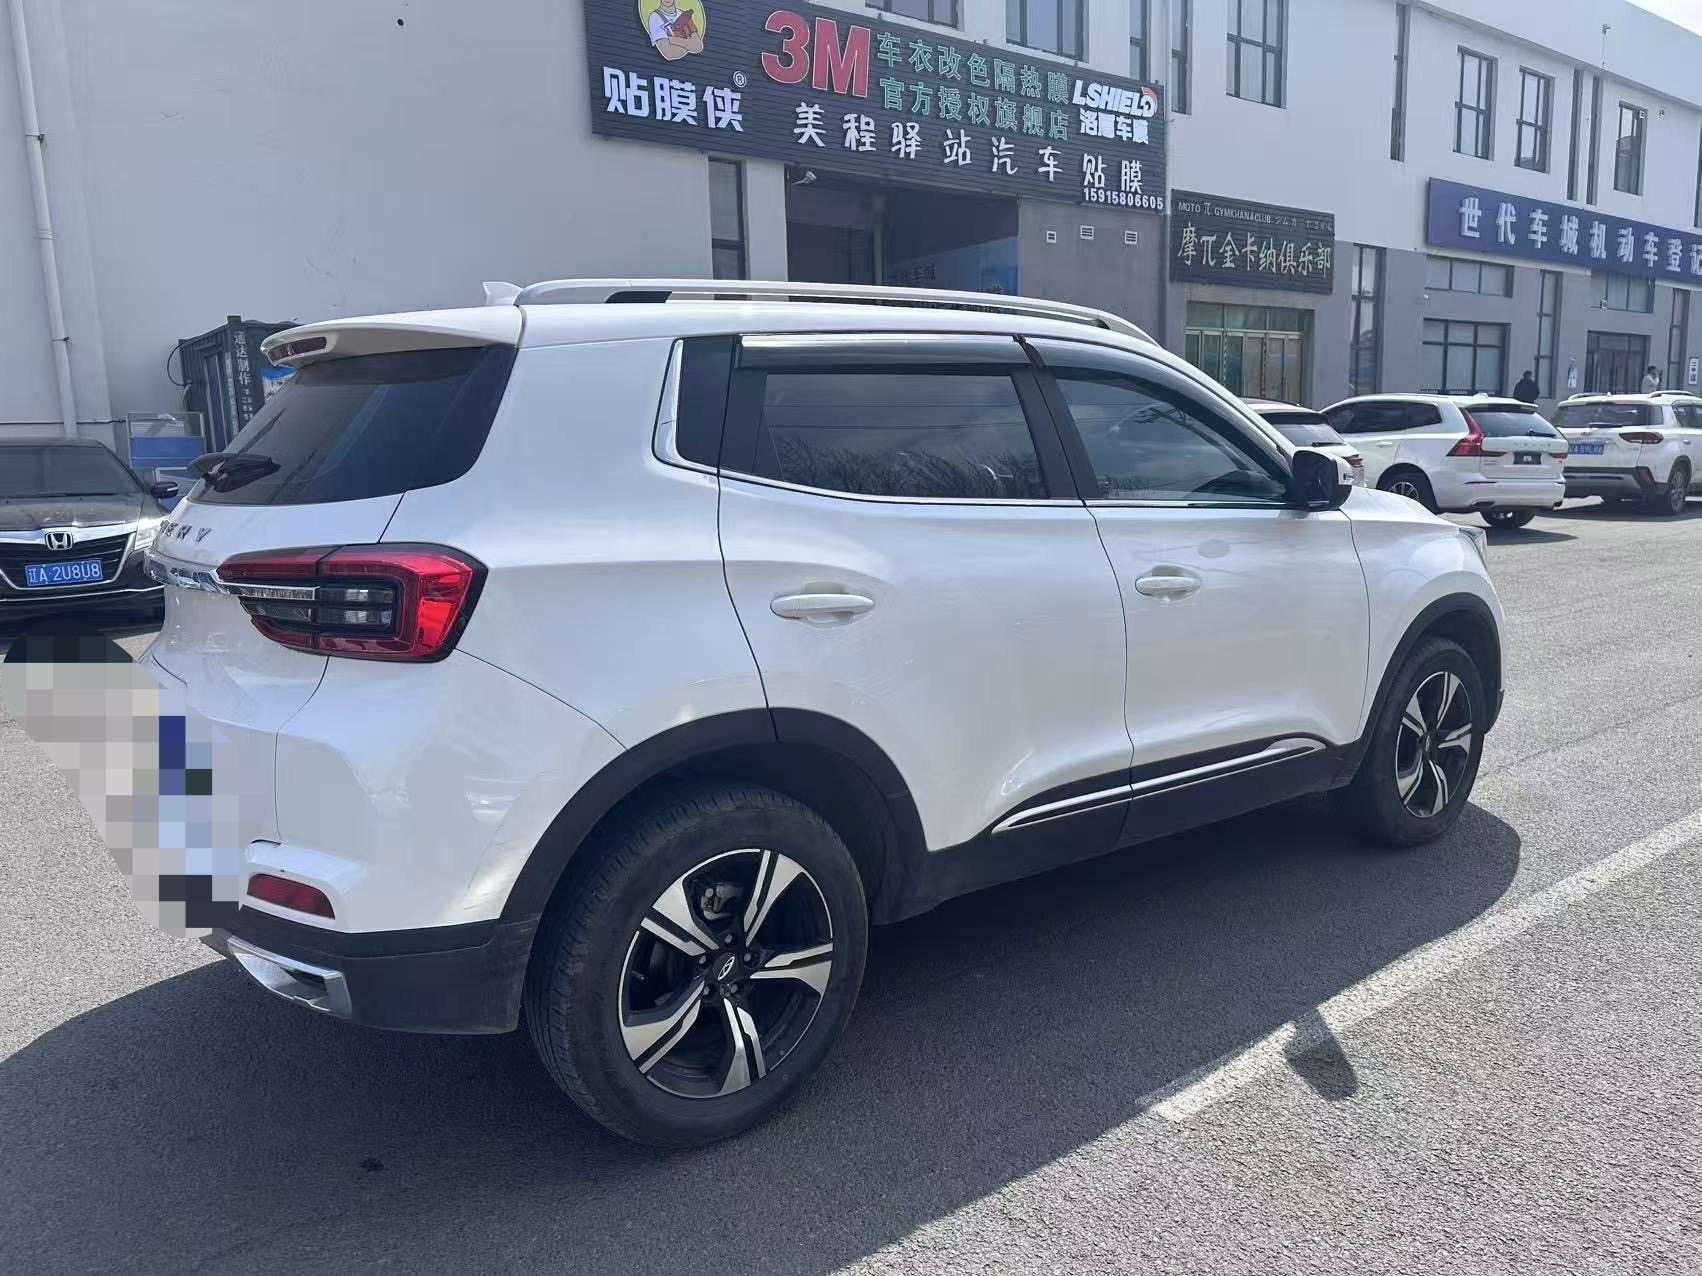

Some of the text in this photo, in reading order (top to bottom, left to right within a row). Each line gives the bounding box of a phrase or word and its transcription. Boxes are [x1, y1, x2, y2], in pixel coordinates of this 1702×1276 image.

[761, 10, 871, 98] 3M
[877, 31, 1069, 104] 车衣改色隔热膜
[603, 66, 743, 132] 贴膜侠
[879, 77, 1068, 140] 官方授权旗舰店
[1072, 80, 1158, 118] LSHIELD
[1083, 187, 1164, 210] 15915806605
[1178, 202, 1201, 213] MOTO
